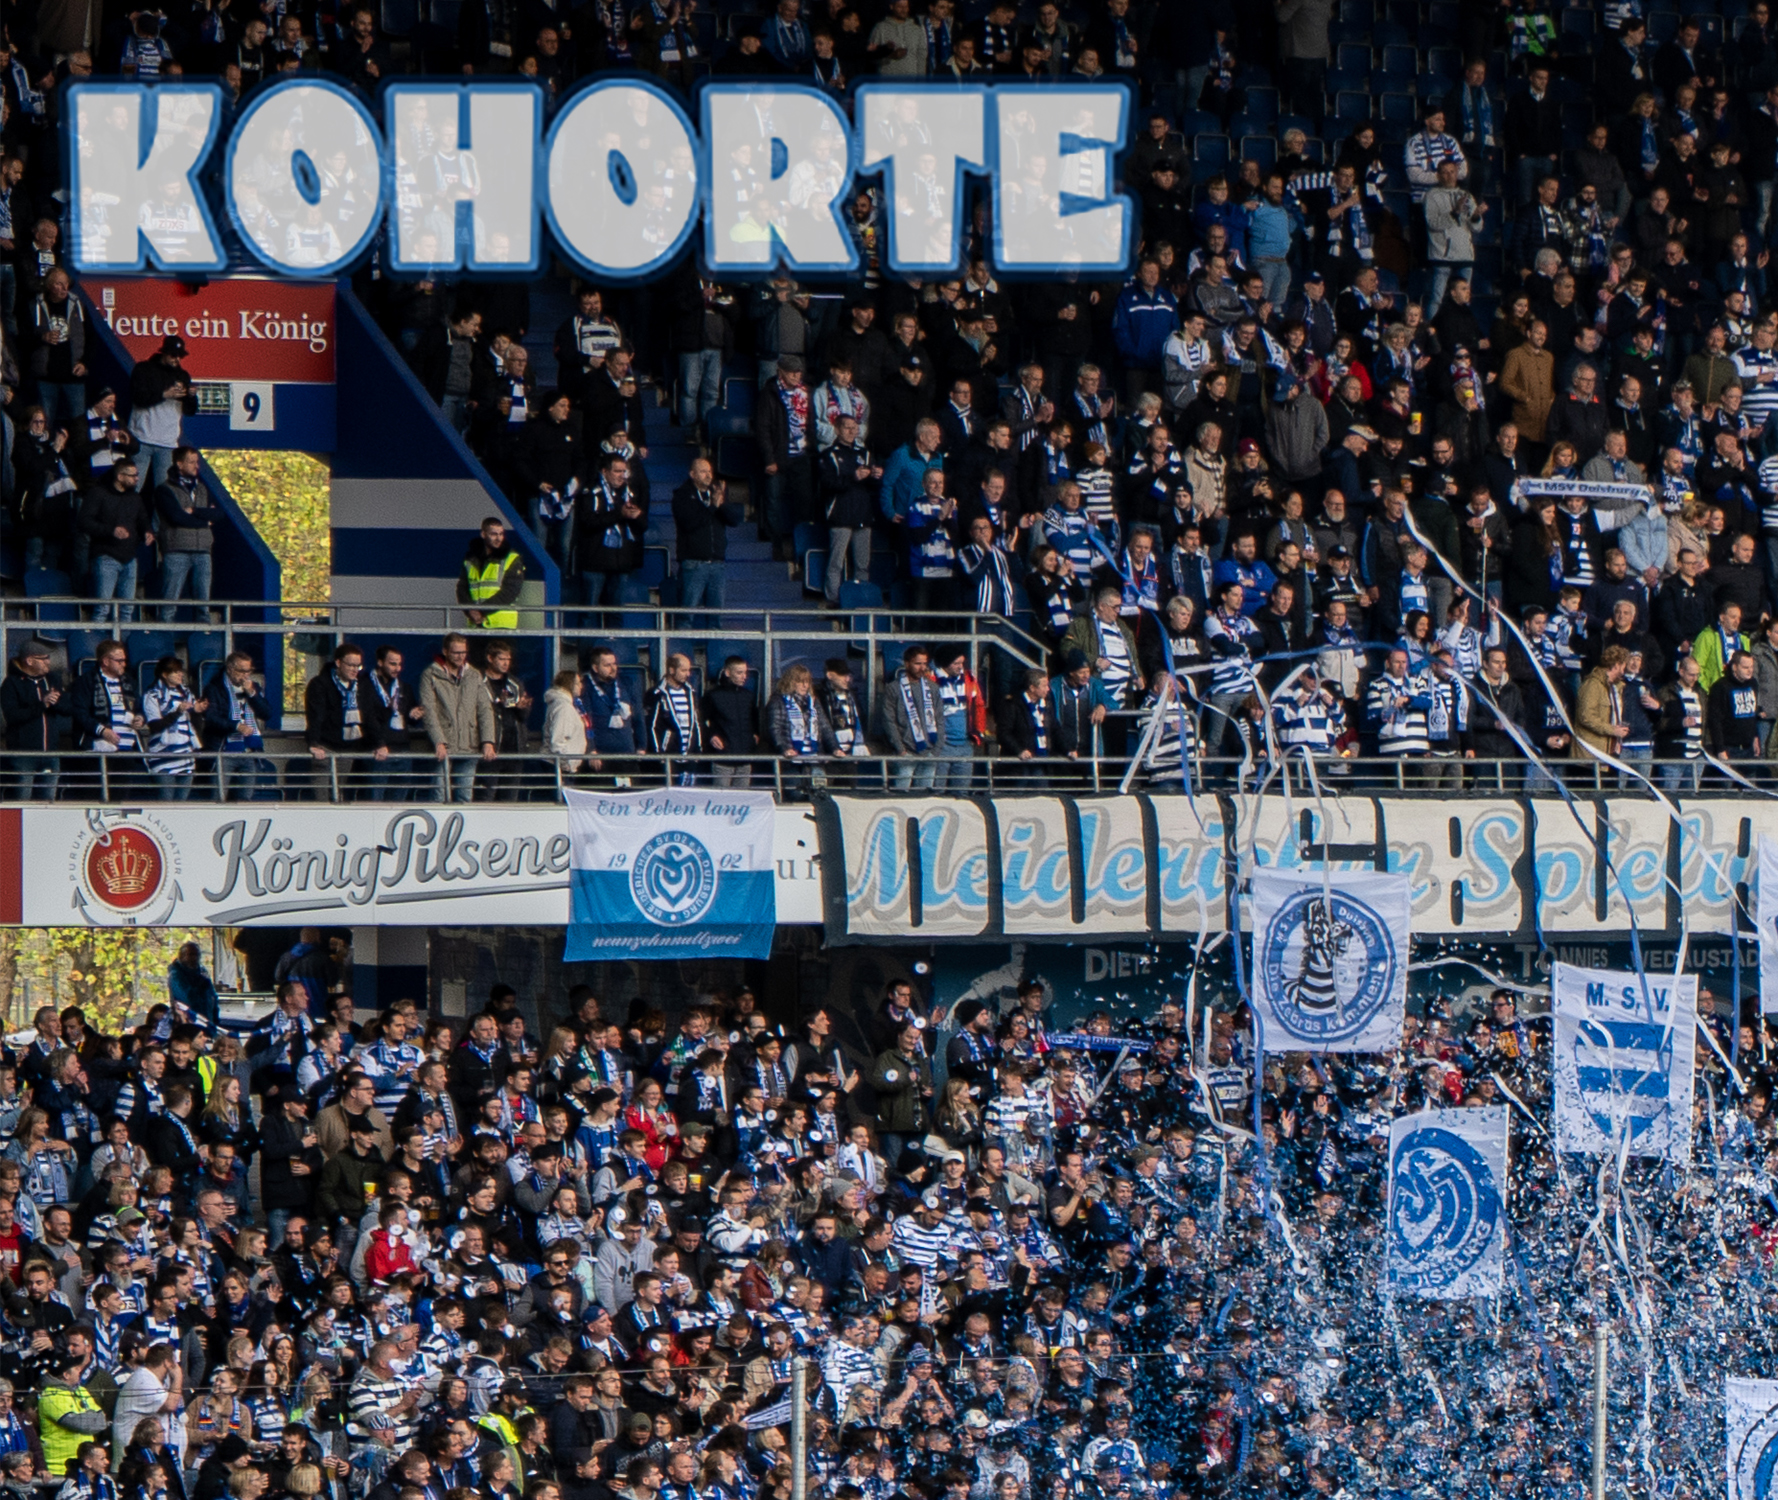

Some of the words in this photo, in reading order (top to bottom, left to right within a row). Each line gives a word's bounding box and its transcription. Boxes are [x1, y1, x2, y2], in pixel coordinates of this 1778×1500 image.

[185, 311, 230, 338] ein
[239, 310, 327, 353] König
[242, 392, 261, 422] 9
[1544, 482, 1575, 491] MSV
[1578, 483, 1641, 497] Duisburg
[597, 800, 630, 816] Ein
[637, 799, 696, 817] Leben
[703, 800, 750, 824] lang
[70, 830, 87, 882] PURUM
[147, 813, 183, 875] LAUDATUR
[201, 818, 391, 906] König
[376, 809, 570, 890] Pilsene
[607, 853, 627, 869] 19
[719, 853, 743, 869] 02
[655, 834, 671, 847] SV
[673, 833, 688, 846] 02
[682, 860, 712, 919] DUISBURG
[1084, 948, 1151, 983] DIETZ
[1634, 948, 1759, 969] WEDAUSTAD
